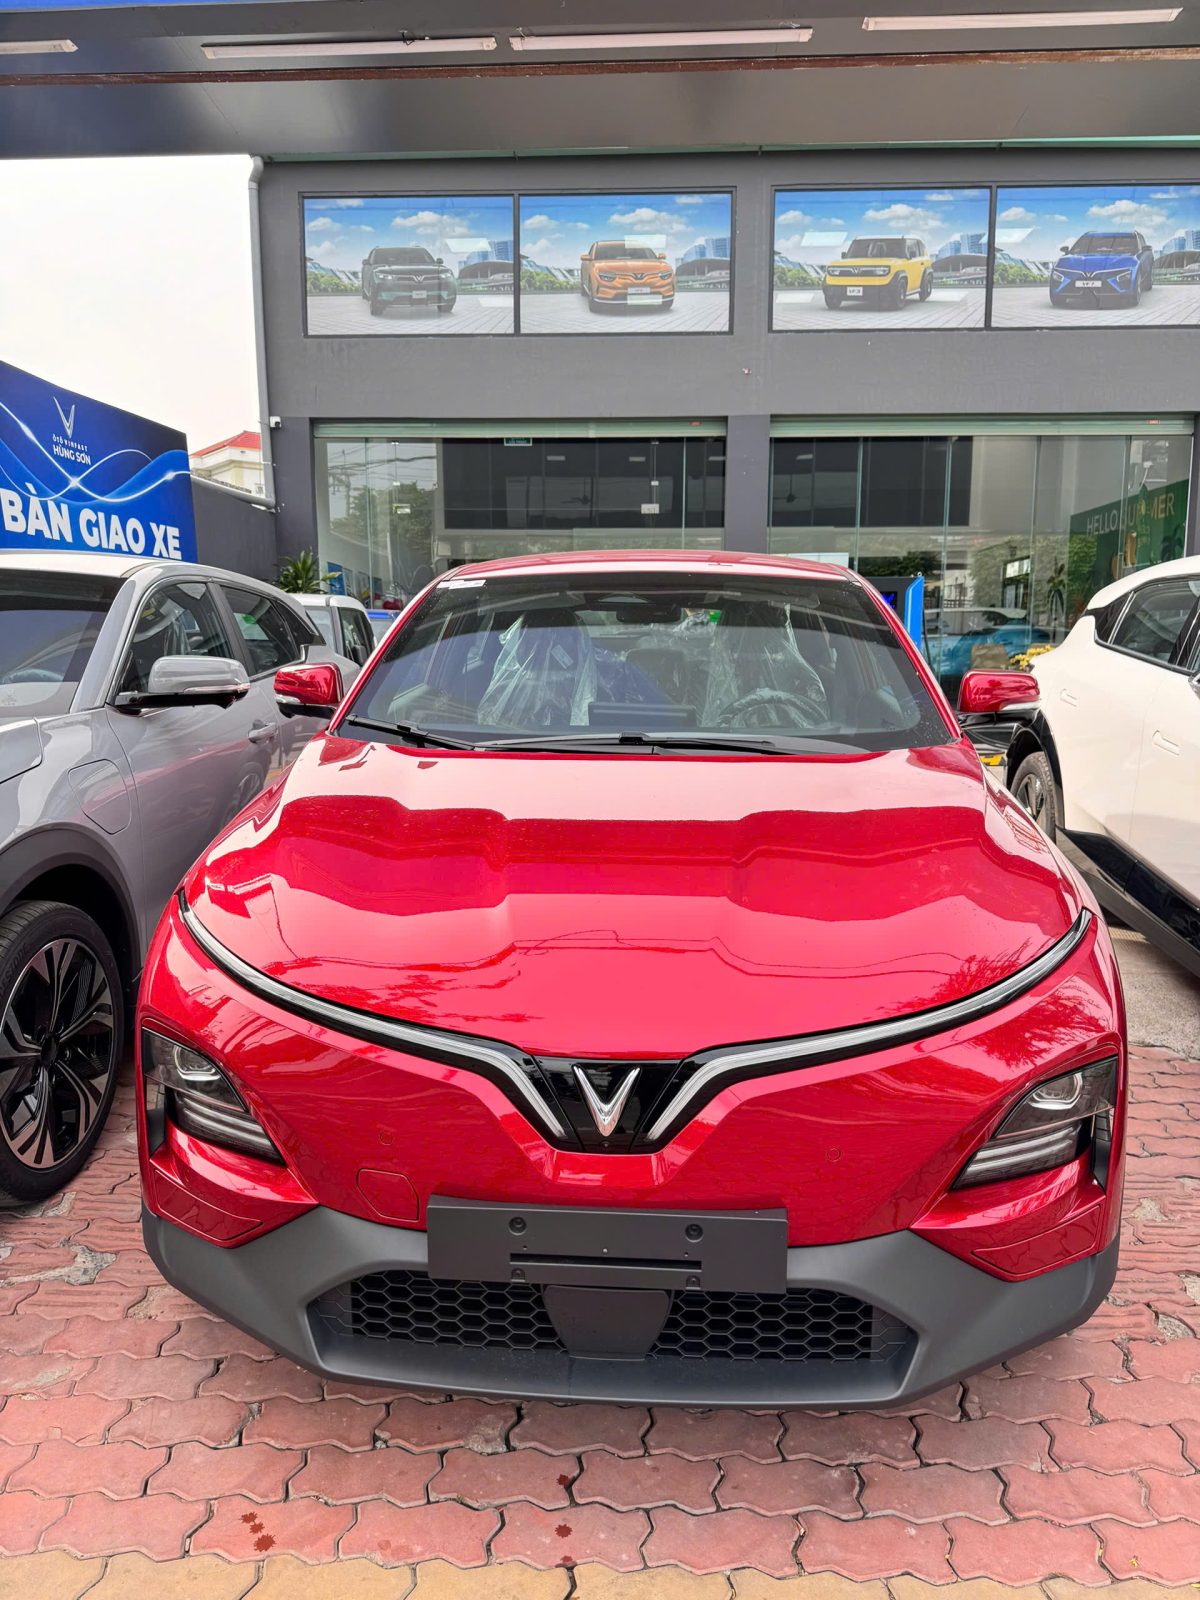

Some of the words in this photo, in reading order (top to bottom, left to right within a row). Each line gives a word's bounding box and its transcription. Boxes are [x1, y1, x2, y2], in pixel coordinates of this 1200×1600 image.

[52, 443, 75, 461] HÙNG
[0, 482, 73, 543] BÀN
[79, 508, 146, 554] GIAO
[150, 522, 182, 560] XE
[1087, 509, 1118, 538] HELLO
